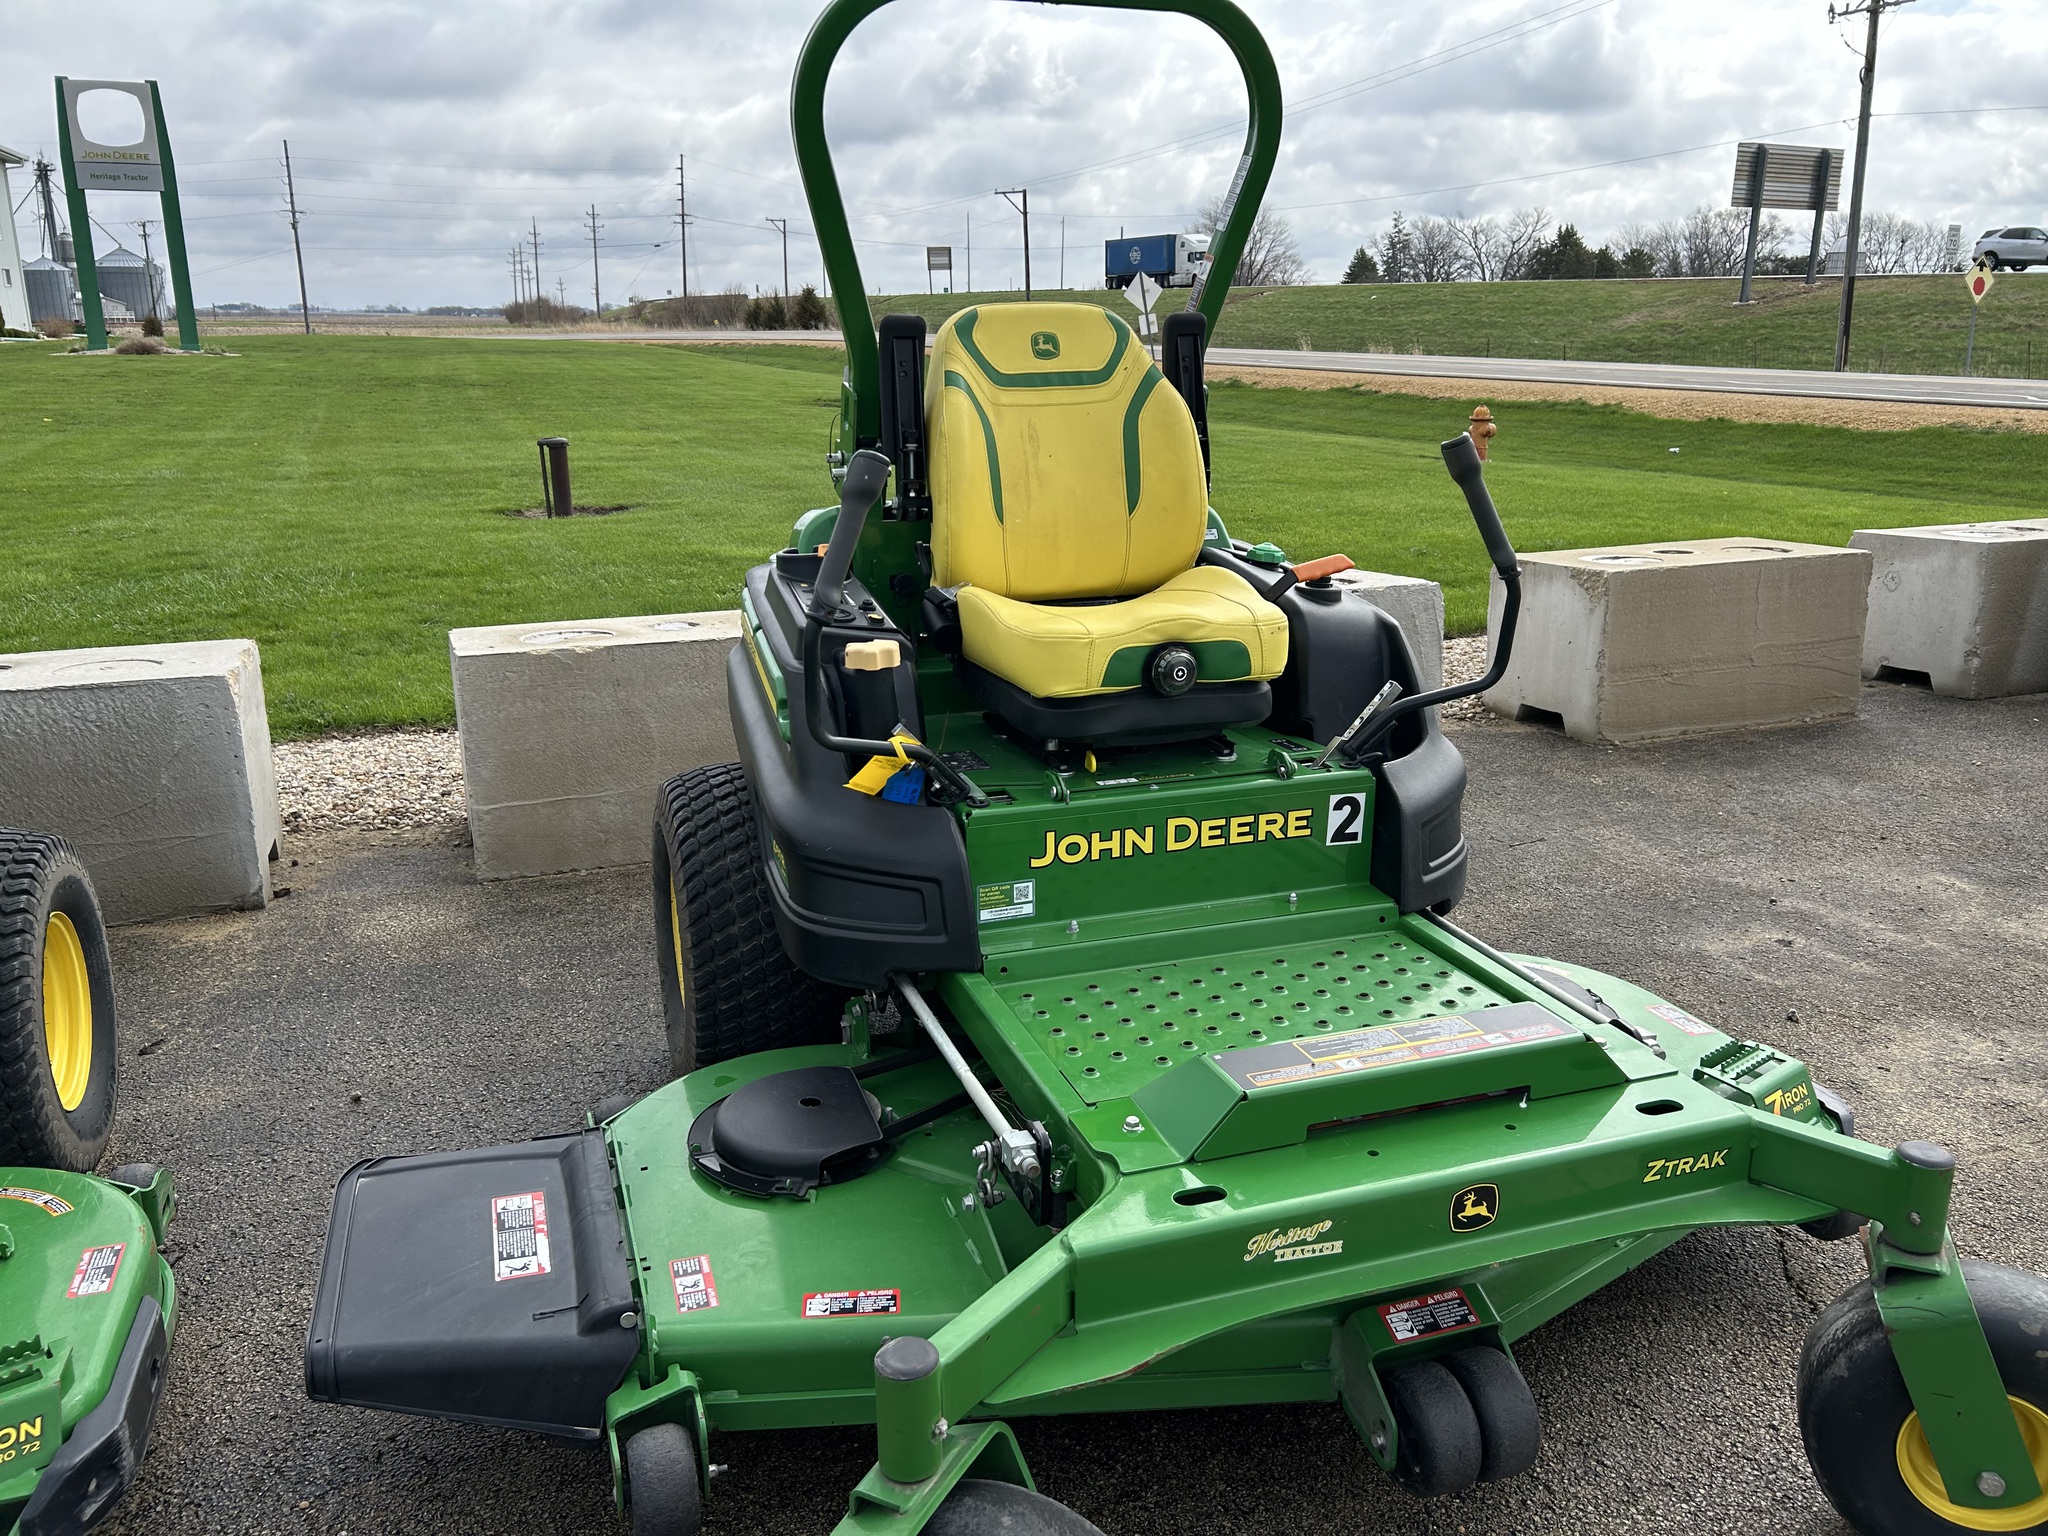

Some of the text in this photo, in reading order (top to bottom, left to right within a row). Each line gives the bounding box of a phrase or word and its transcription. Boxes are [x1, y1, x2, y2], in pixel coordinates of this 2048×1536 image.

[82, 150, 150, 160] JOHN DEERE
[90, 173, 149, 181] Heritage Tractor
[1949, 239, 1957, 247] 70
[1330, 796, 1362, 844] 2
[1029, 808, 1314, 869] JOHN DEERE
[1793, 1098, 1811, 1114] PRO 72
[1642, 1148, 1729, 1183] ZTRAK
[1244, 1220, 1332, 1261] Heritage
[1274, 1240, 1343, 1262] TRACTOR
[1433, 1290, 1458, 1301] PELIGRO
[1396, 1299, 1420, 1310] DANGER
[21, 1441, 41, 1455] 72
